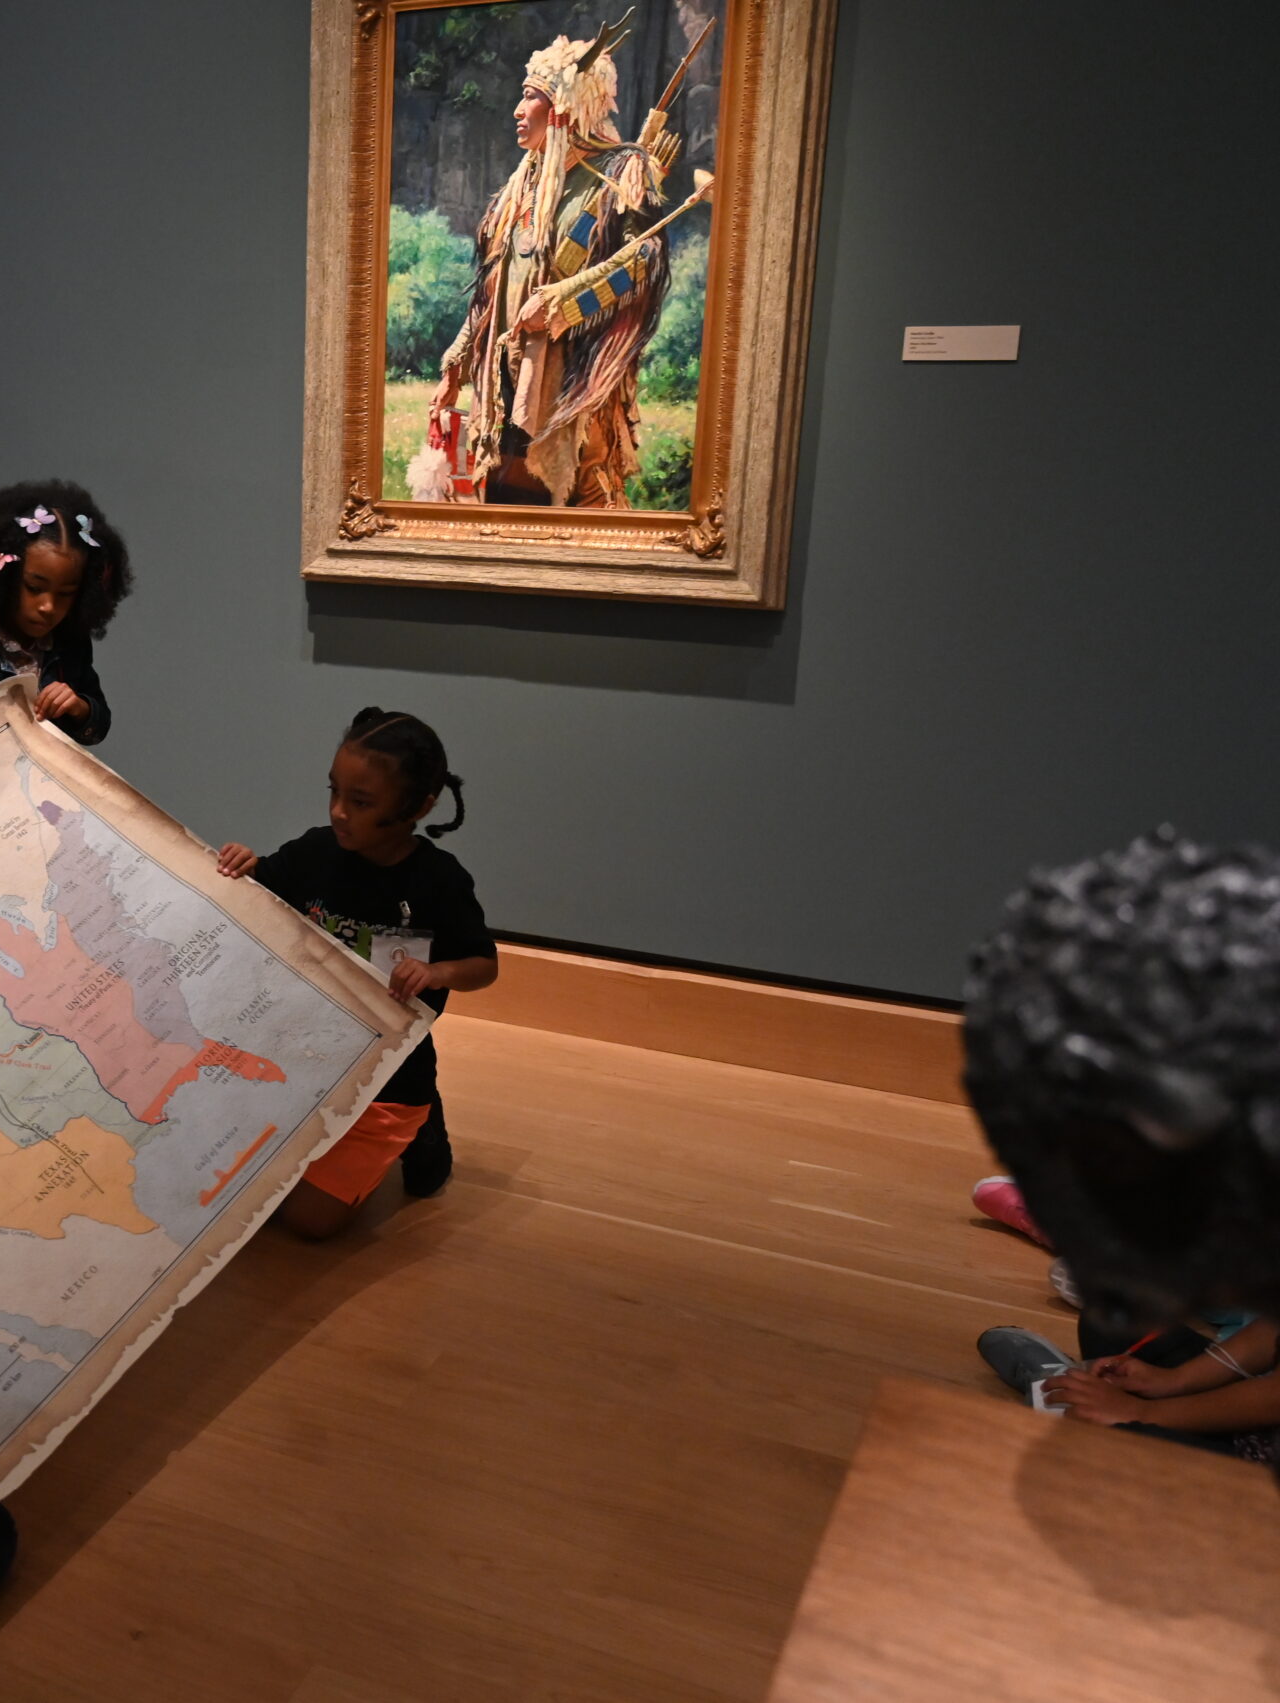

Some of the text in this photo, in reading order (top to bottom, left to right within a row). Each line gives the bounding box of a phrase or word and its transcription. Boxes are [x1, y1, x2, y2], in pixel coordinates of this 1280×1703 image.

[162, 922, 228, 987] THIRTEEN STATES
[168, 929, 208, 967] ORIGINAL
[65, 983, 98, 1012] UNITED
[97, 958, 125, 987] STATES
[236, 987, 272, 1024] ATLANTIC
[250, 1000, 273, 1024] OCEAN
[194, 1036, 231, 1068] FLORIDA
[203, 1042, 238, 1077] CESSION
[194, 1151, 213, 1172] Gulf
[216, 1125, 239, 1149] Mexico
[33, 1150, 90, 1203] ANNEXATION
[38, 1154, 68, 1182] TEXAS
[59, 1264, 99, 1303] MEXICO
